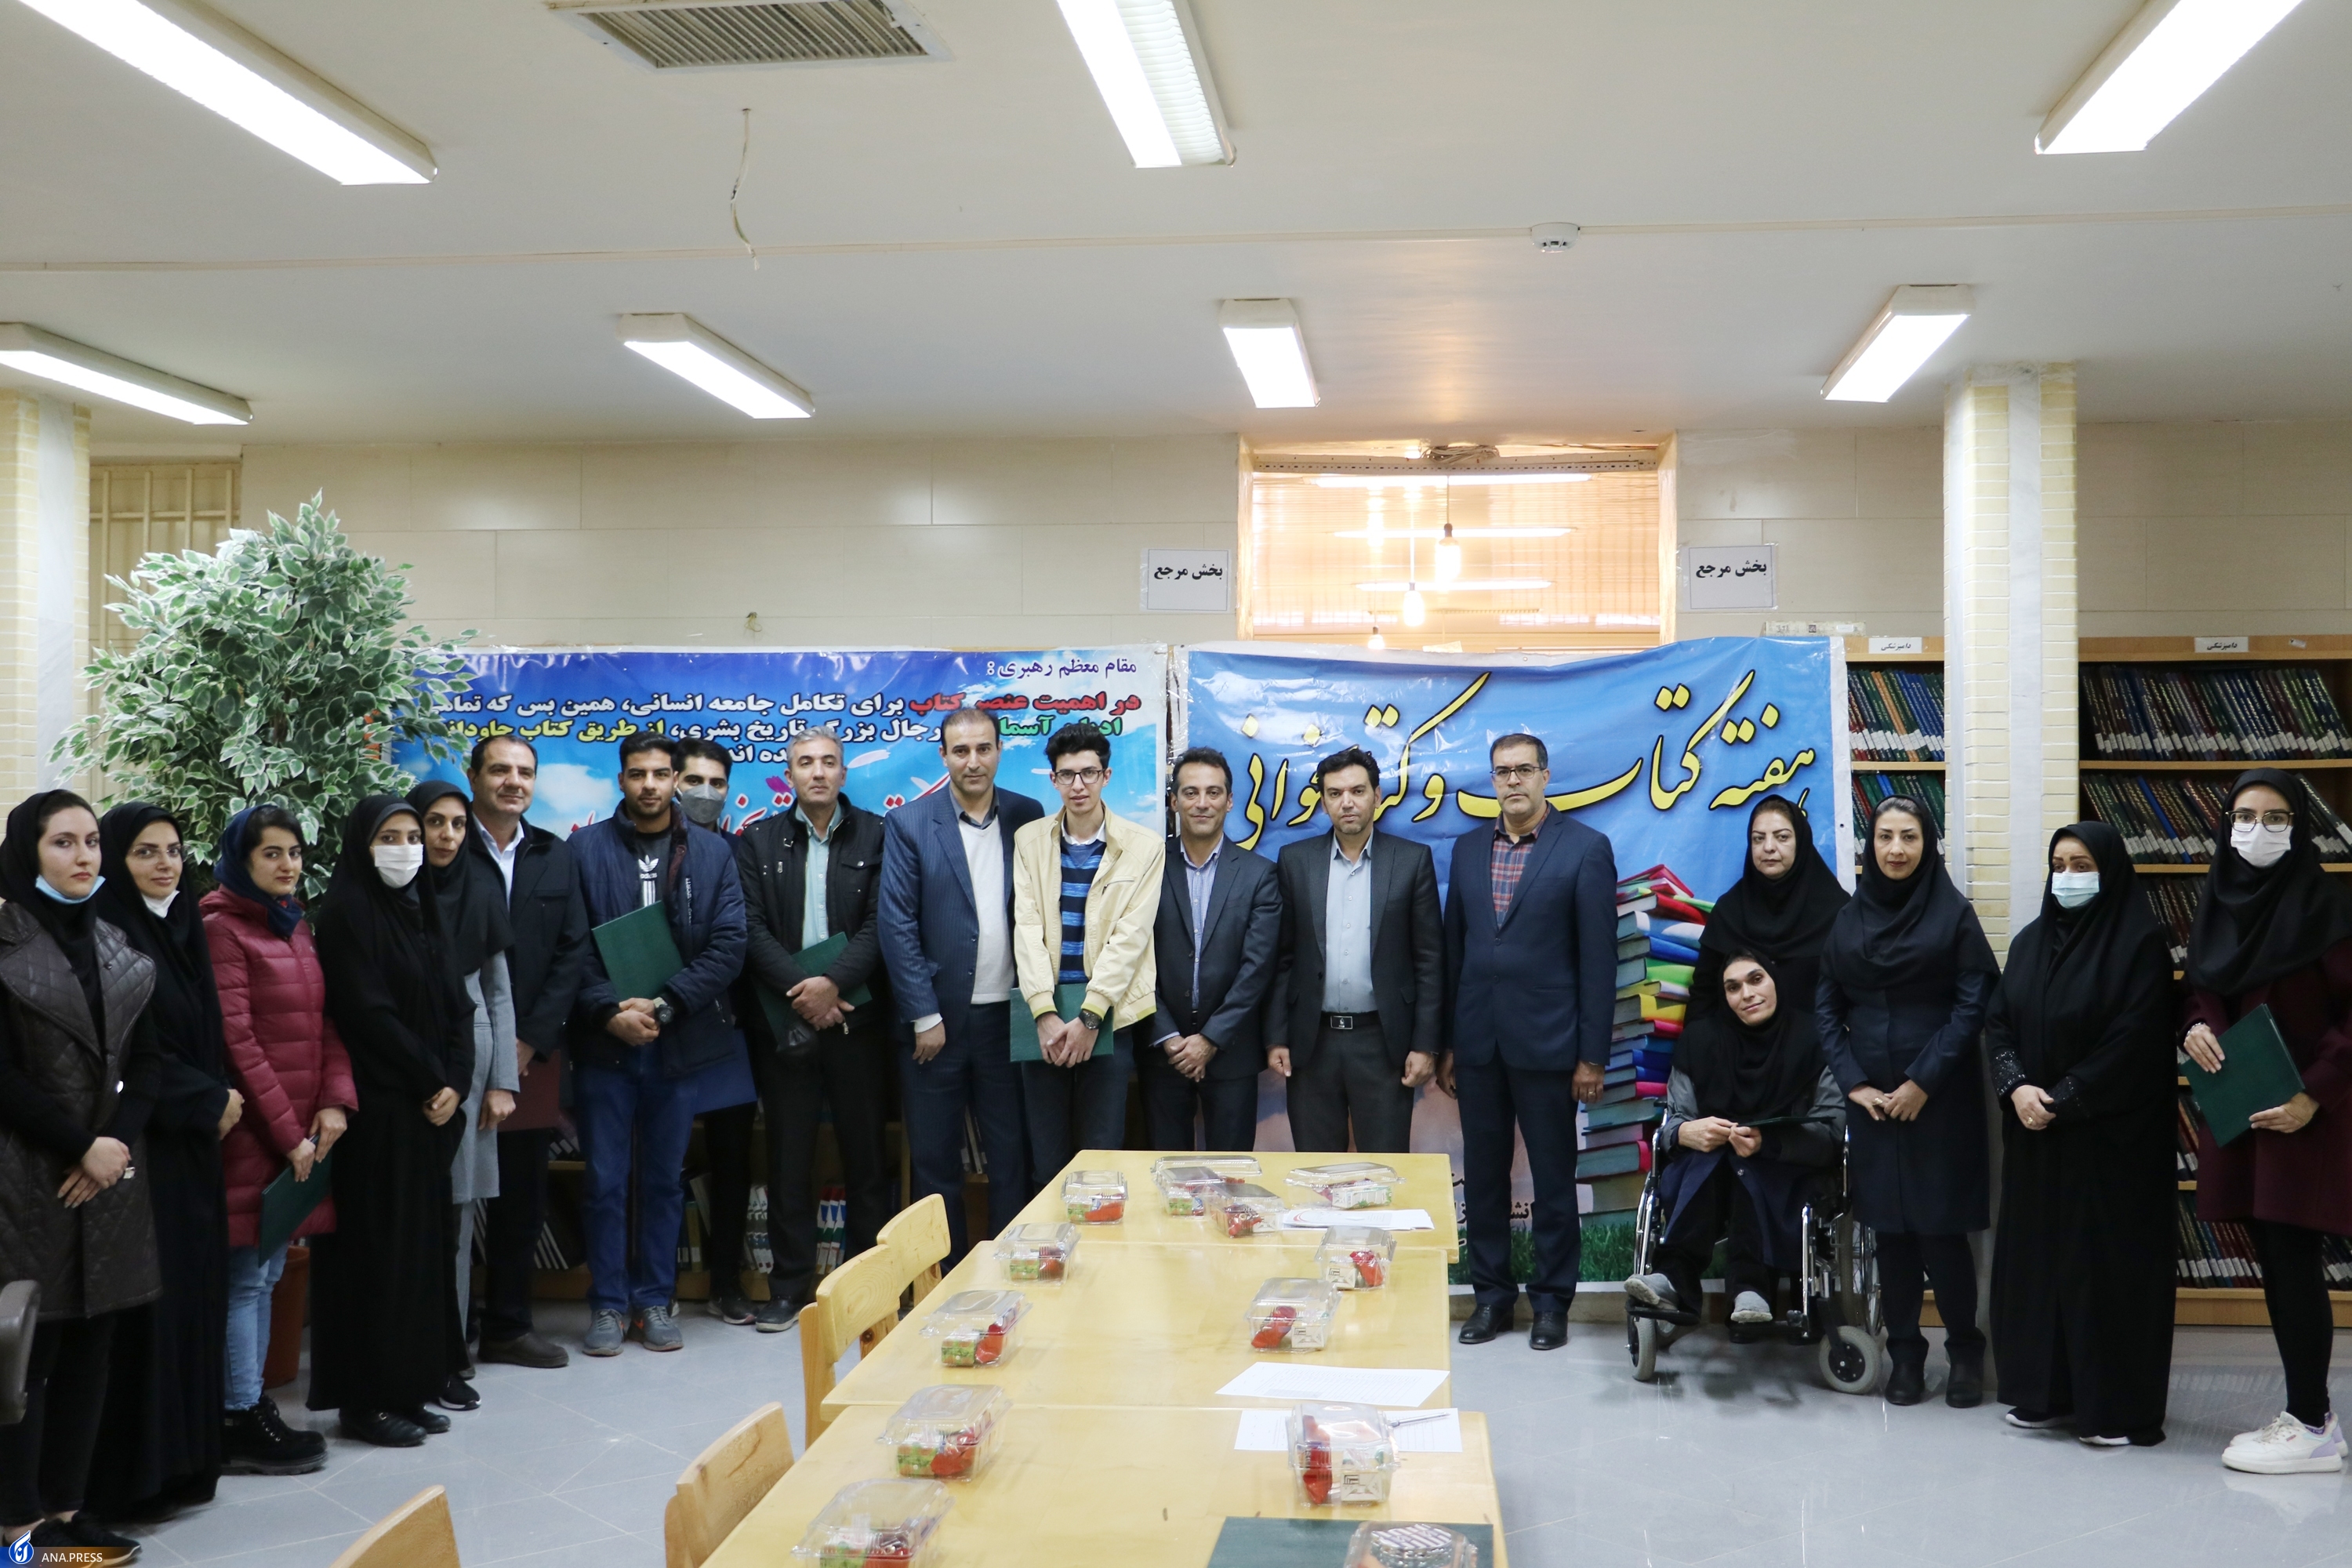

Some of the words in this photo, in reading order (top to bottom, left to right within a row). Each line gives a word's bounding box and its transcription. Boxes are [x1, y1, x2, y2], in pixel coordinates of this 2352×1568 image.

[1154, 566, 1188, 580] مرجع
[1192, 564, 1222, 580] بخش
[1696, 563, 1731, 579] مرجع
[1735, 560, 1767, 576] بخش
[1058, 659, 1099, 679] معظم
[1105, 659, 1137, 678] مقام
[486, 694, 513, 713] که
[516, 698, 555, 717] بس
[560, 696, 615, 717] همین
[709, 693, 775, 715] جامعه
[779, 692, 845, 715] تکامل
[850, 692, 904, 717] برای
[909, 692, 967, 716] کتاب
[975, 692, 1029, 711] عنص
[1033, 691, 1107, 714] اهمیت
[1109, 695, 1142, 716] در
[519, 719, 573, 739] کتاب
[577, 719, 637, 742] طریق
[746, 718, 805, 742] تاریخ
[1456, 670, 1756, 820] کتاب
[1709, 702, 1817, 816] هفته
